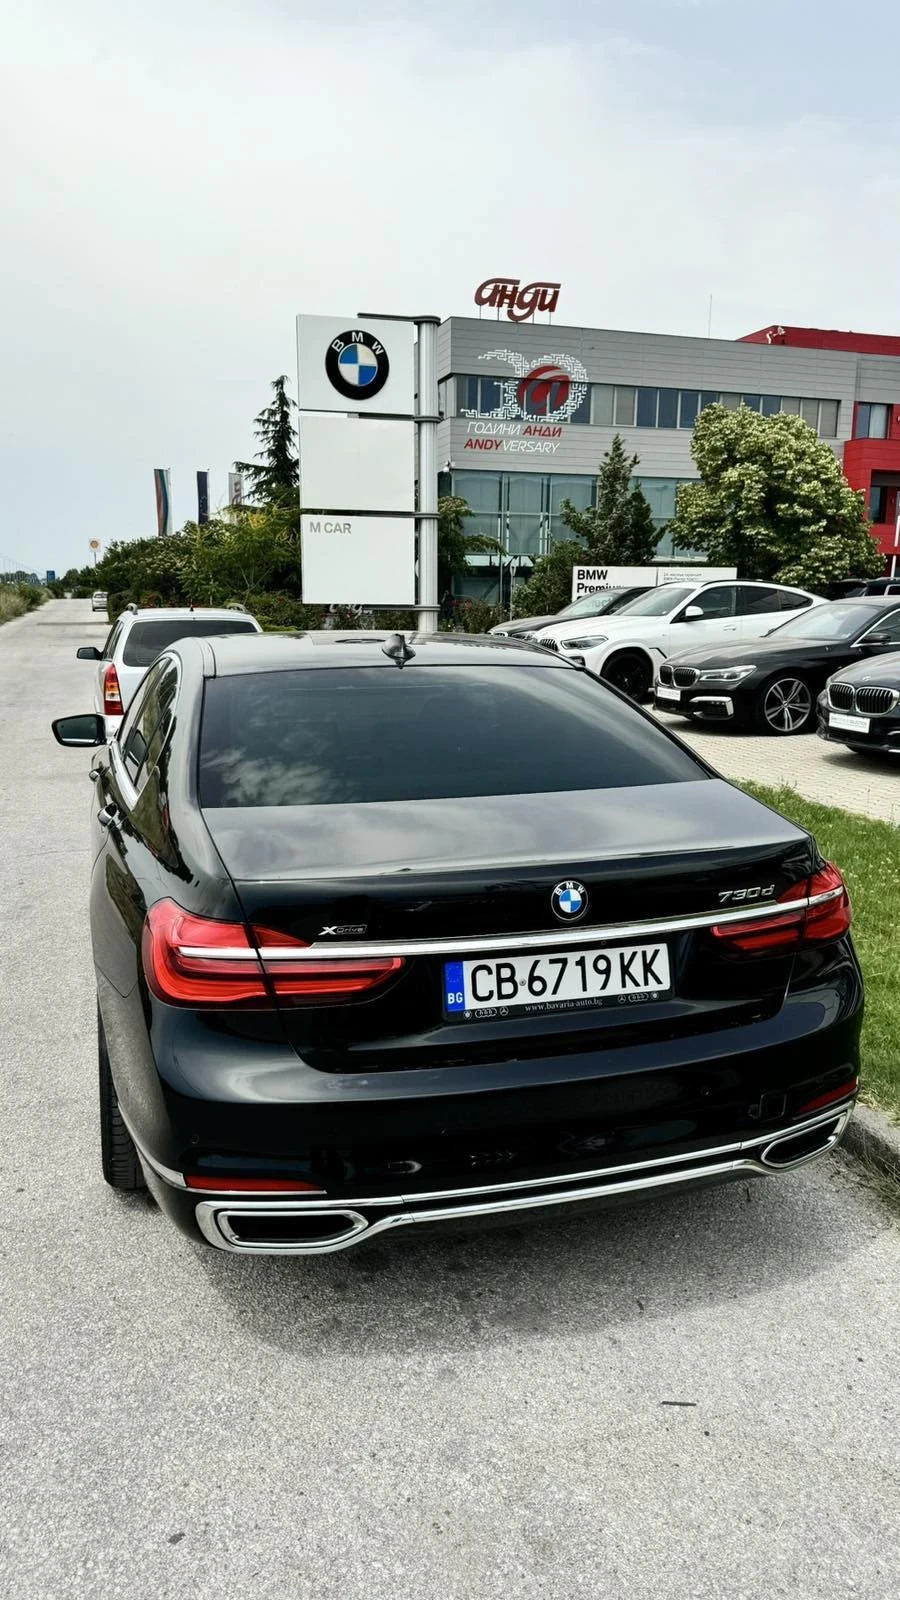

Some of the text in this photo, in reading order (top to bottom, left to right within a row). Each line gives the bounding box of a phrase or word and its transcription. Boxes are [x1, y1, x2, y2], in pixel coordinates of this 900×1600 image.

[331, 331, 384, 355] BMW
[467, 421, 563, 437] ГОДИНИ АНДИ
[464, 438, 561, 453] ANDYVERSARY
[309, 521, 352, 534] M CAR
[577, 569, 608, 580] BMW
[577, 582, 624, 594] Premi
[554, 881, 585, 896] BMW
[718, 884, 776, 903] 730d
[447, 992, 464, 1005] BG
[524, 997, 604, 1013] www.bavaria-auto.bg
